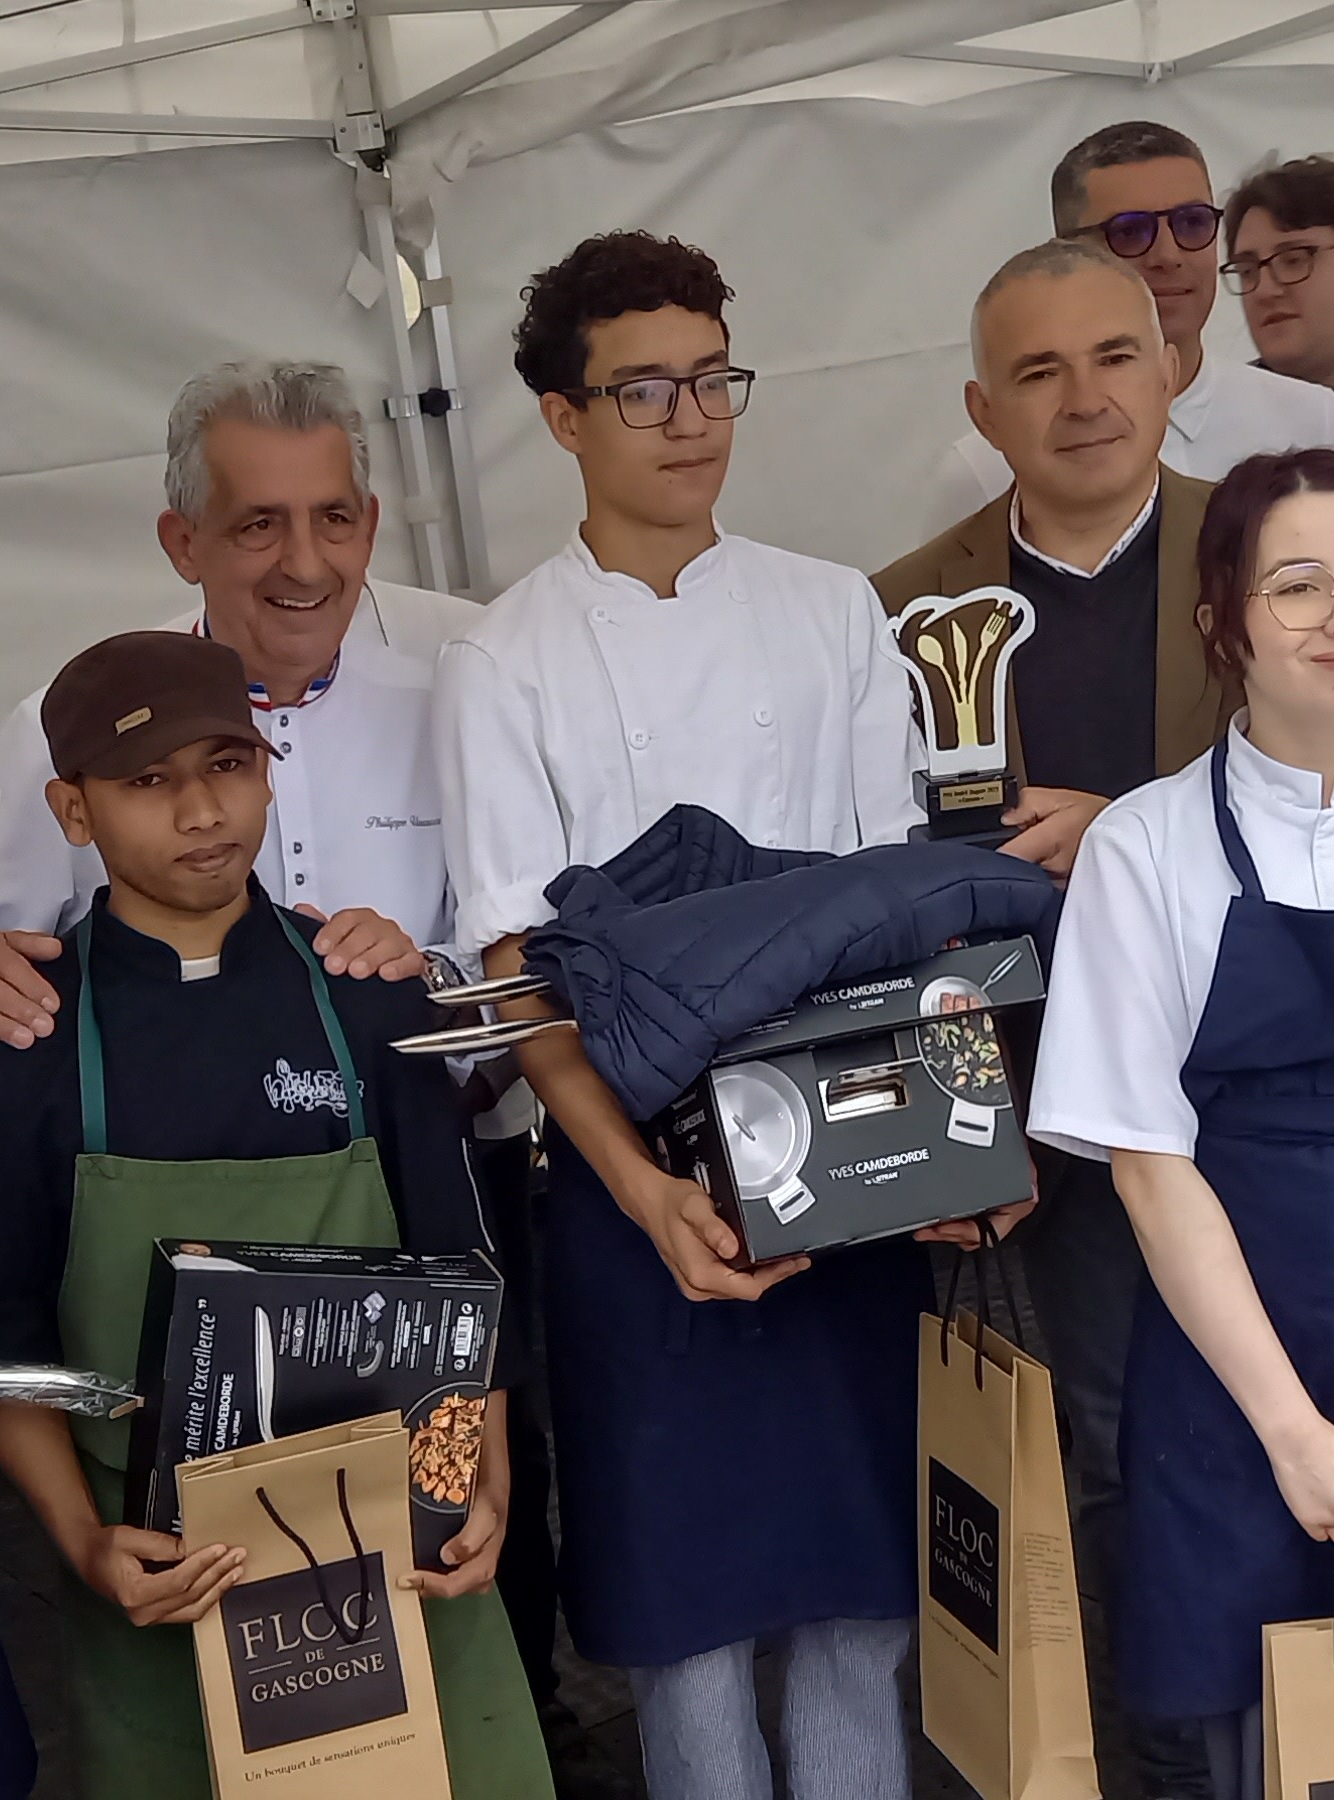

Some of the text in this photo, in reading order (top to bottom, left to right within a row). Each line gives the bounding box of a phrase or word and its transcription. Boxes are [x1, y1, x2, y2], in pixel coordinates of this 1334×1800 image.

[810, 977, 915, 1006] YVES CAMDEBORDE
[828, 1148, 930, 1180] YVES CAMDEBORDE
[187, 1313, 216, 1399] l'excellence
[183, 1401, 206, 1451] mérite
[214, 1373, 235, 1451] CAMDEBORDE
[934, 1494, 994, 1568] FLOC
[934, 1547, 993, 1608] GASCOGNE
[237, 1591, 378, 1661] FLOC
[251, 1652, 385, 1703] GASCOGNE
[305, 1648, 326, 1664] DE
[244, 1770, 262, 1783] Un
[264, 1760, 307, 1778] bouquet
[309, 1756, 321, 1767] de
[324, 1744, 375, 1763] sensations
